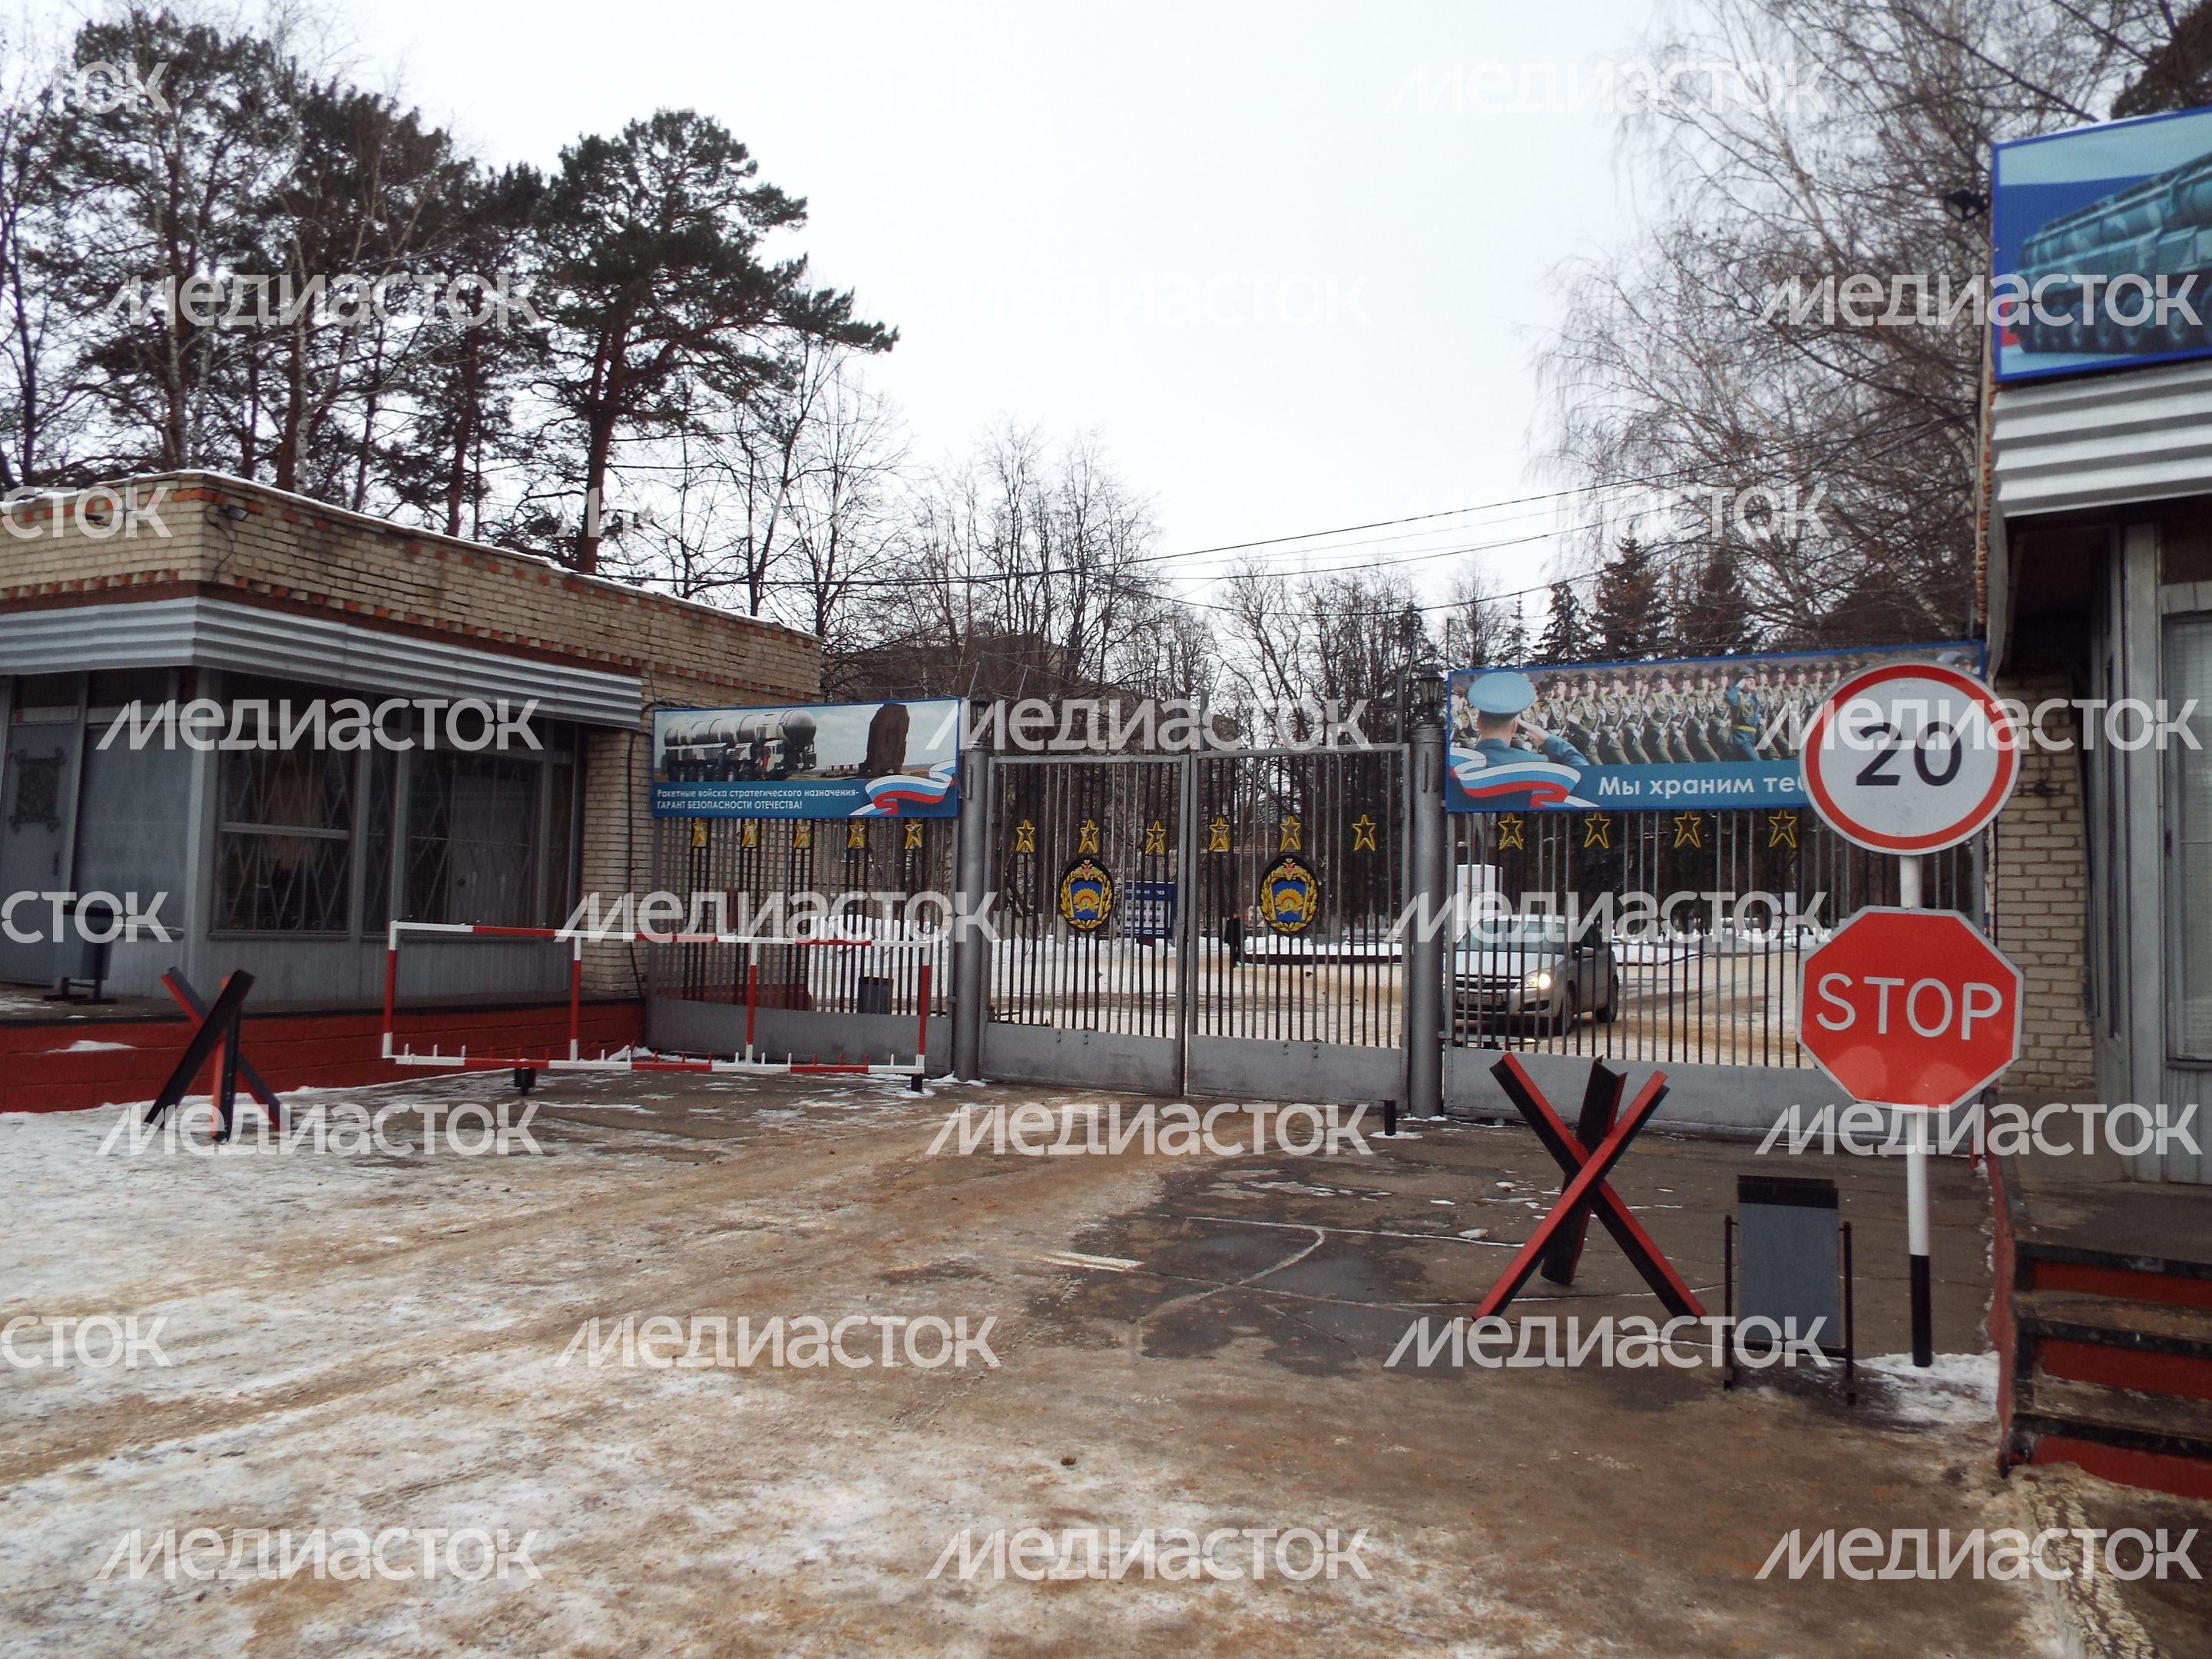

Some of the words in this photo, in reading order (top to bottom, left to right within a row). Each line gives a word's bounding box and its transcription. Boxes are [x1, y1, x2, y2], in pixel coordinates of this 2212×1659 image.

[1855, 721, 1963, 787] 20
[657, 789, 697, 797] Ракетные
[698, 788, 727, 797] войска
[729, 790, 802, 799] стратегического
[1598, 777, 1640, 795] Мы
[1649, 777, 1755, 800] храним
[1763, 775, 1805, 793] те
[657, 800, 686, 810] ГАРАНТ
[687, 800, 753, 810] БЕЗОПАСНОСТИ
[754, 800, 803, 810] ОТЕЧЕСТВА!
[1816, 972, 2003, 1041] STOP
